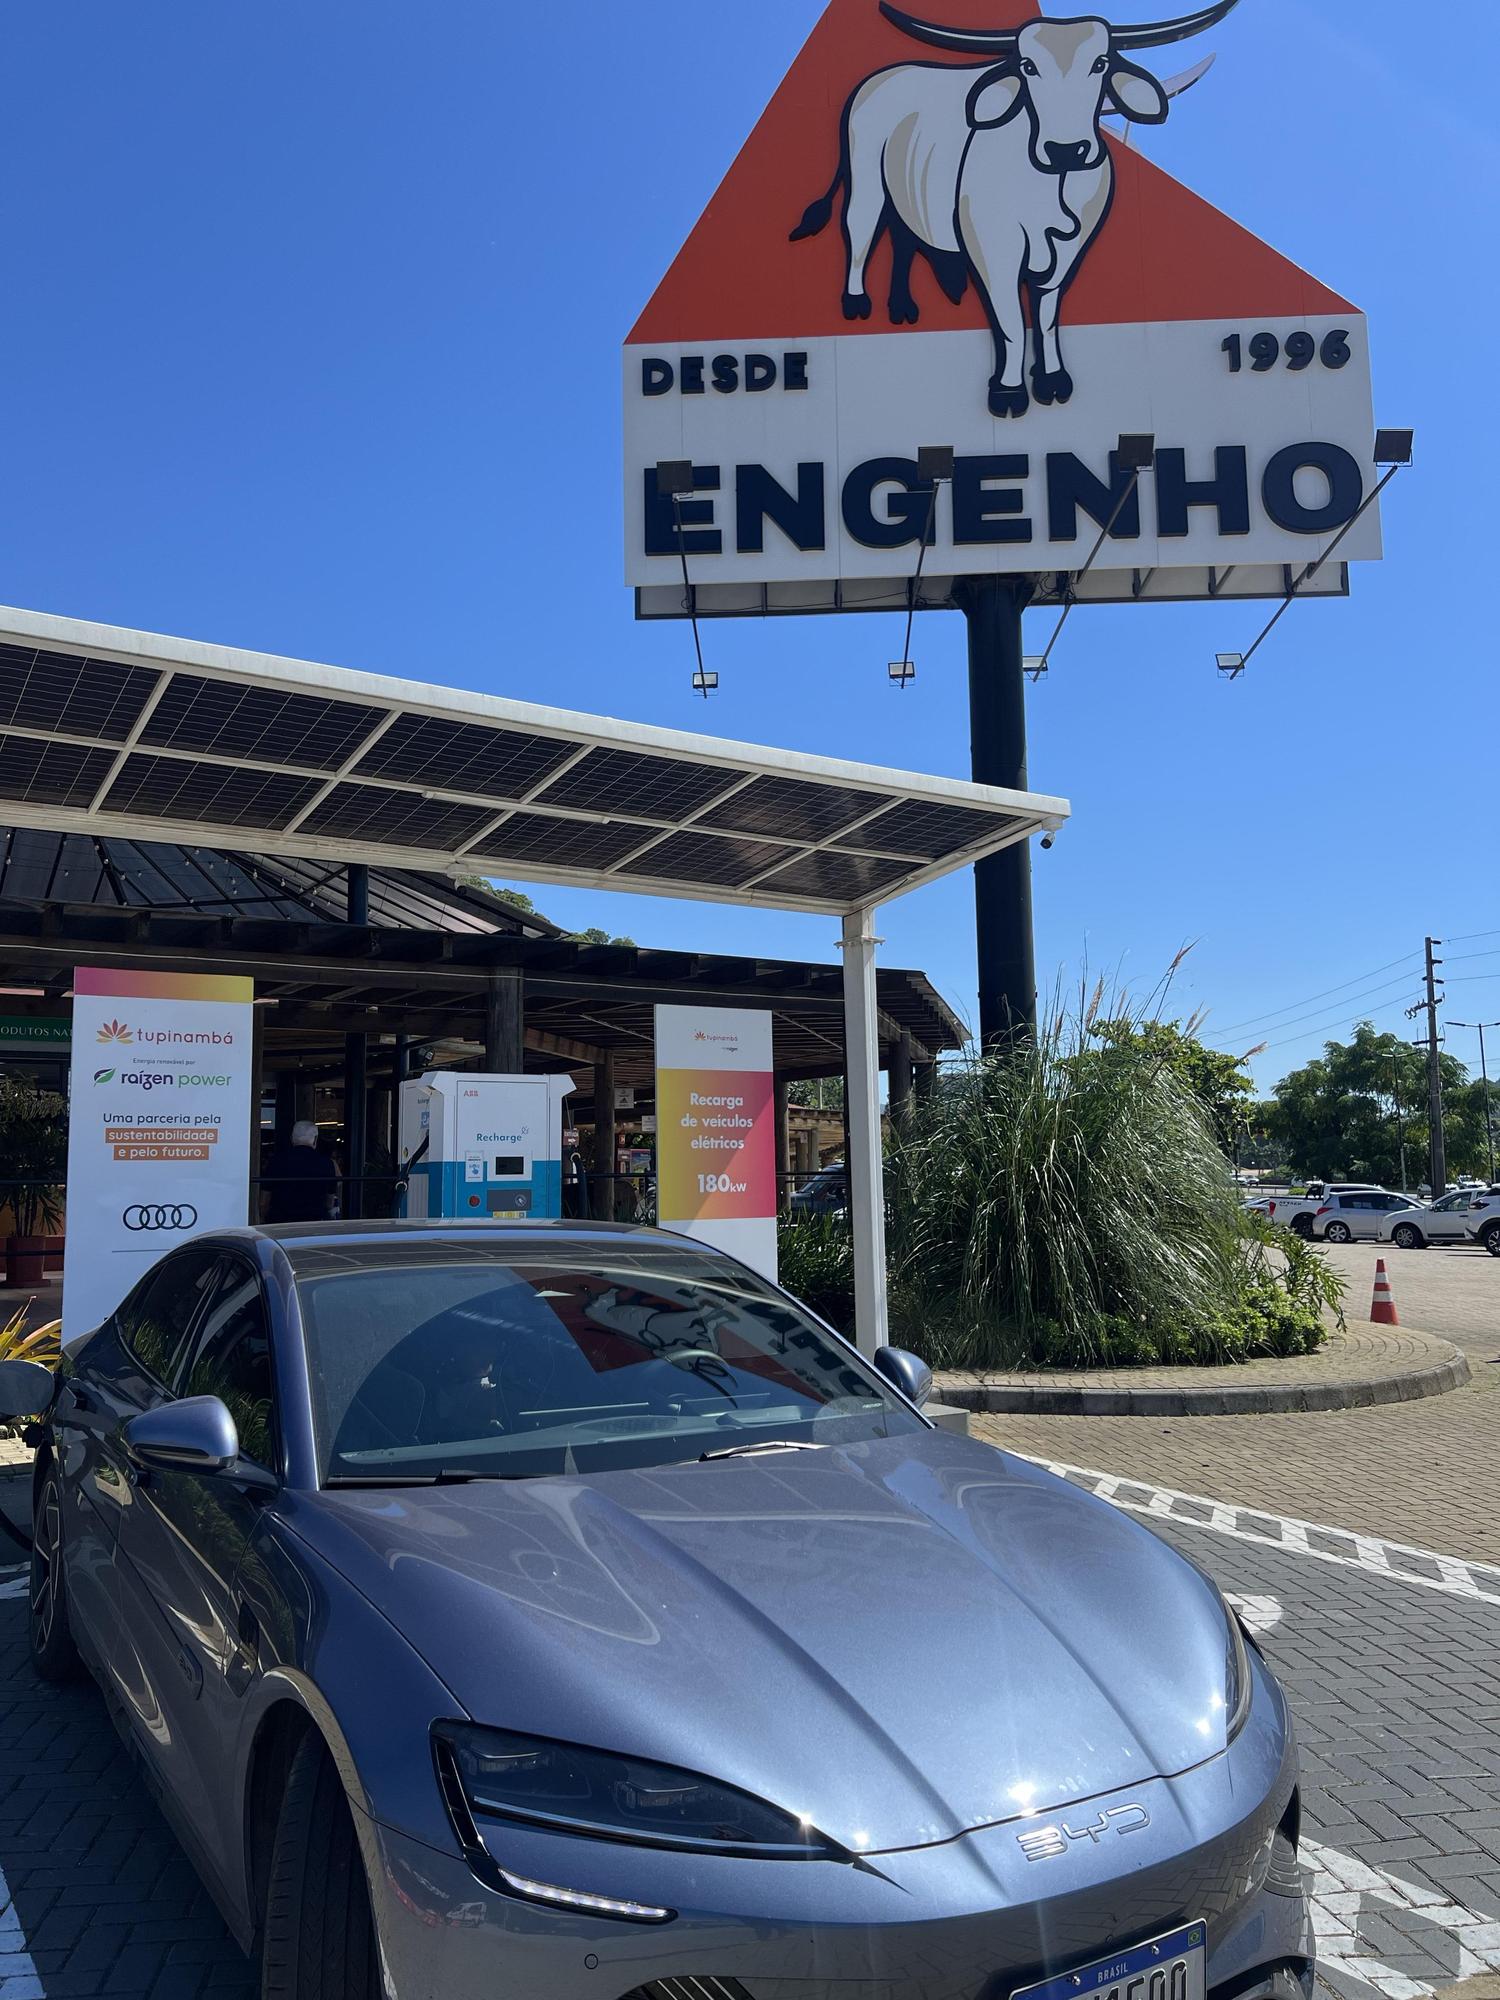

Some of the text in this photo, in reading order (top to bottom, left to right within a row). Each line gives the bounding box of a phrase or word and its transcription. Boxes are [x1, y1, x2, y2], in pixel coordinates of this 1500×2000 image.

[1221, 329, 1351, 373] 1996
[642, 351, 808, 396] DESDE
[643, 441, 1363, 556] ENGENHO
[137, 1028, 233, 1045] tupinambá
[121, 1070, 232, 1091] raízen power
[690, 1092, 744, 1109] Recarga
[103, 1112, 222, 1126] Uma parceria pela
[681, 1113, 753, 1127] de veículos
[108, 1130, 215, 1141] sustentabilidade
[476, 1133, 522, 1143] Recharge
[691, 1135, 745, 1149] elétricos
[118, 1147, 205, 1159] e pelo futuro.
[1016, 1802, 1151, 1862] BYD
[1097, 1962, 1129, 1983] BRASIL
